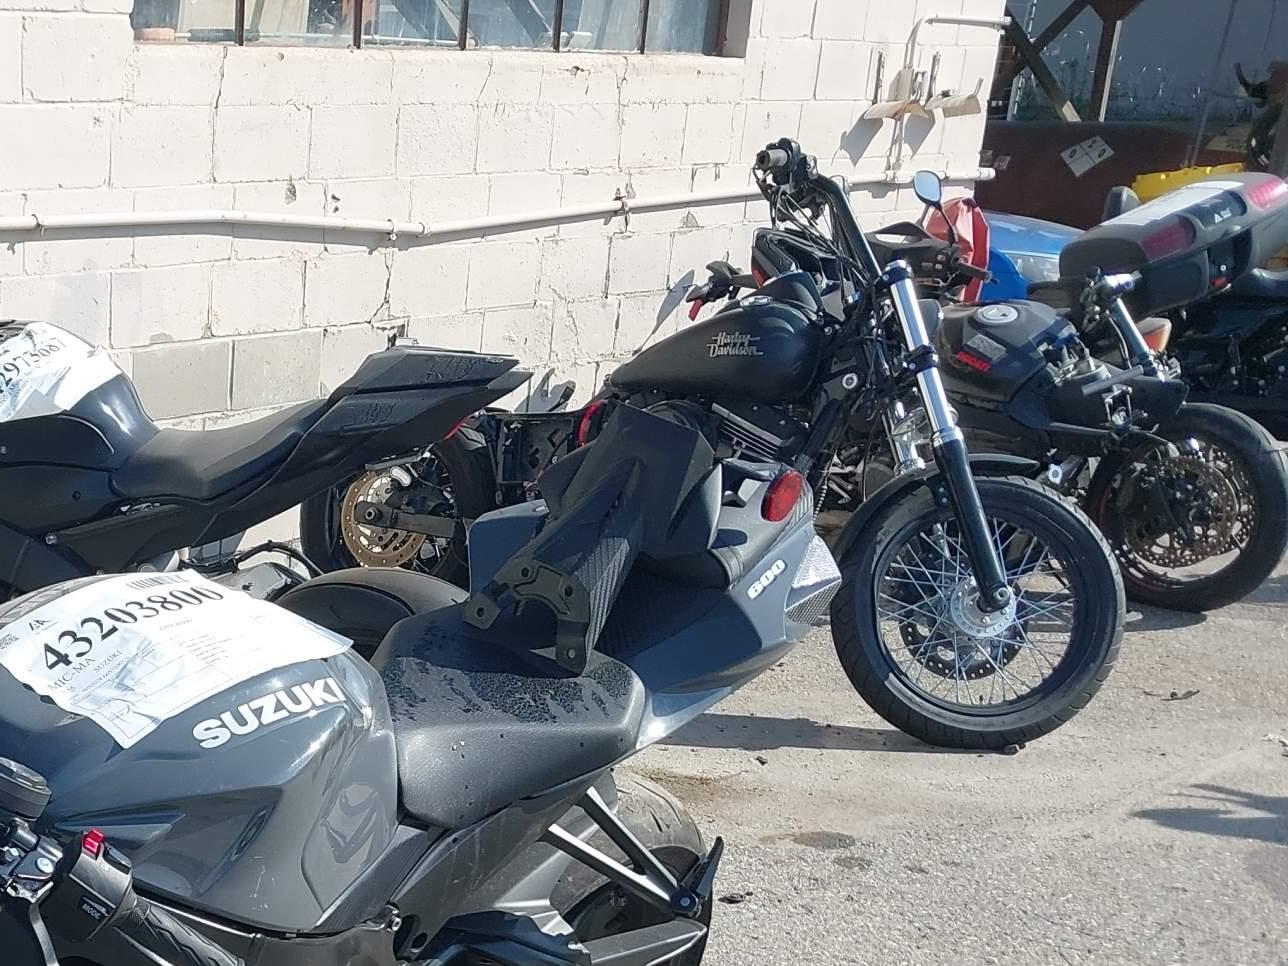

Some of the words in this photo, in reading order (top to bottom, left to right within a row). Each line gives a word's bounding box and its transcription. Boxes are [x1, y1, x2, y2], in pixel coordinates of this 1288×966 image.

[707, 343, 764, 358] Davidson
[712, 332, 760, 346] Harley
[747, 559, 787, 600] 600
[43, 585, 225, 672] 43203800
[192, 676, 347, 749] SUZUKI
[81, 903, 101, 920] MODE
